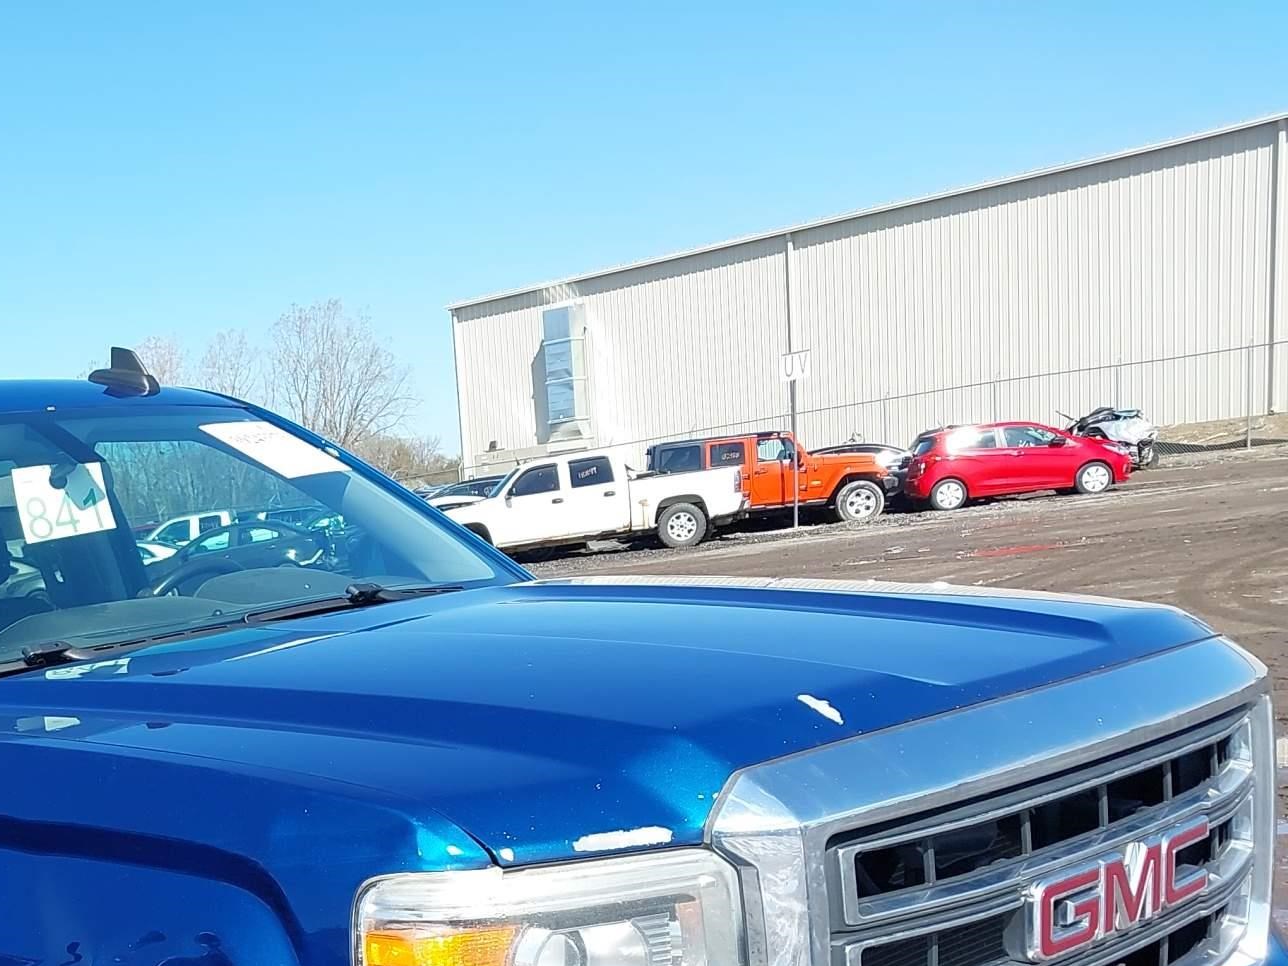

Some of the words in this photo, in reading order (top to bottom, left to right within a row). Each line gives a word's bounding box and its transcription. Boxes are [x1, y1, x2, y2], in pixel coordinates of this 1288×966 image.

[784, 352, 808, 377] UV
[25, 487, 105, 540] 841
[1032, 816, 1210, 961] GMC
